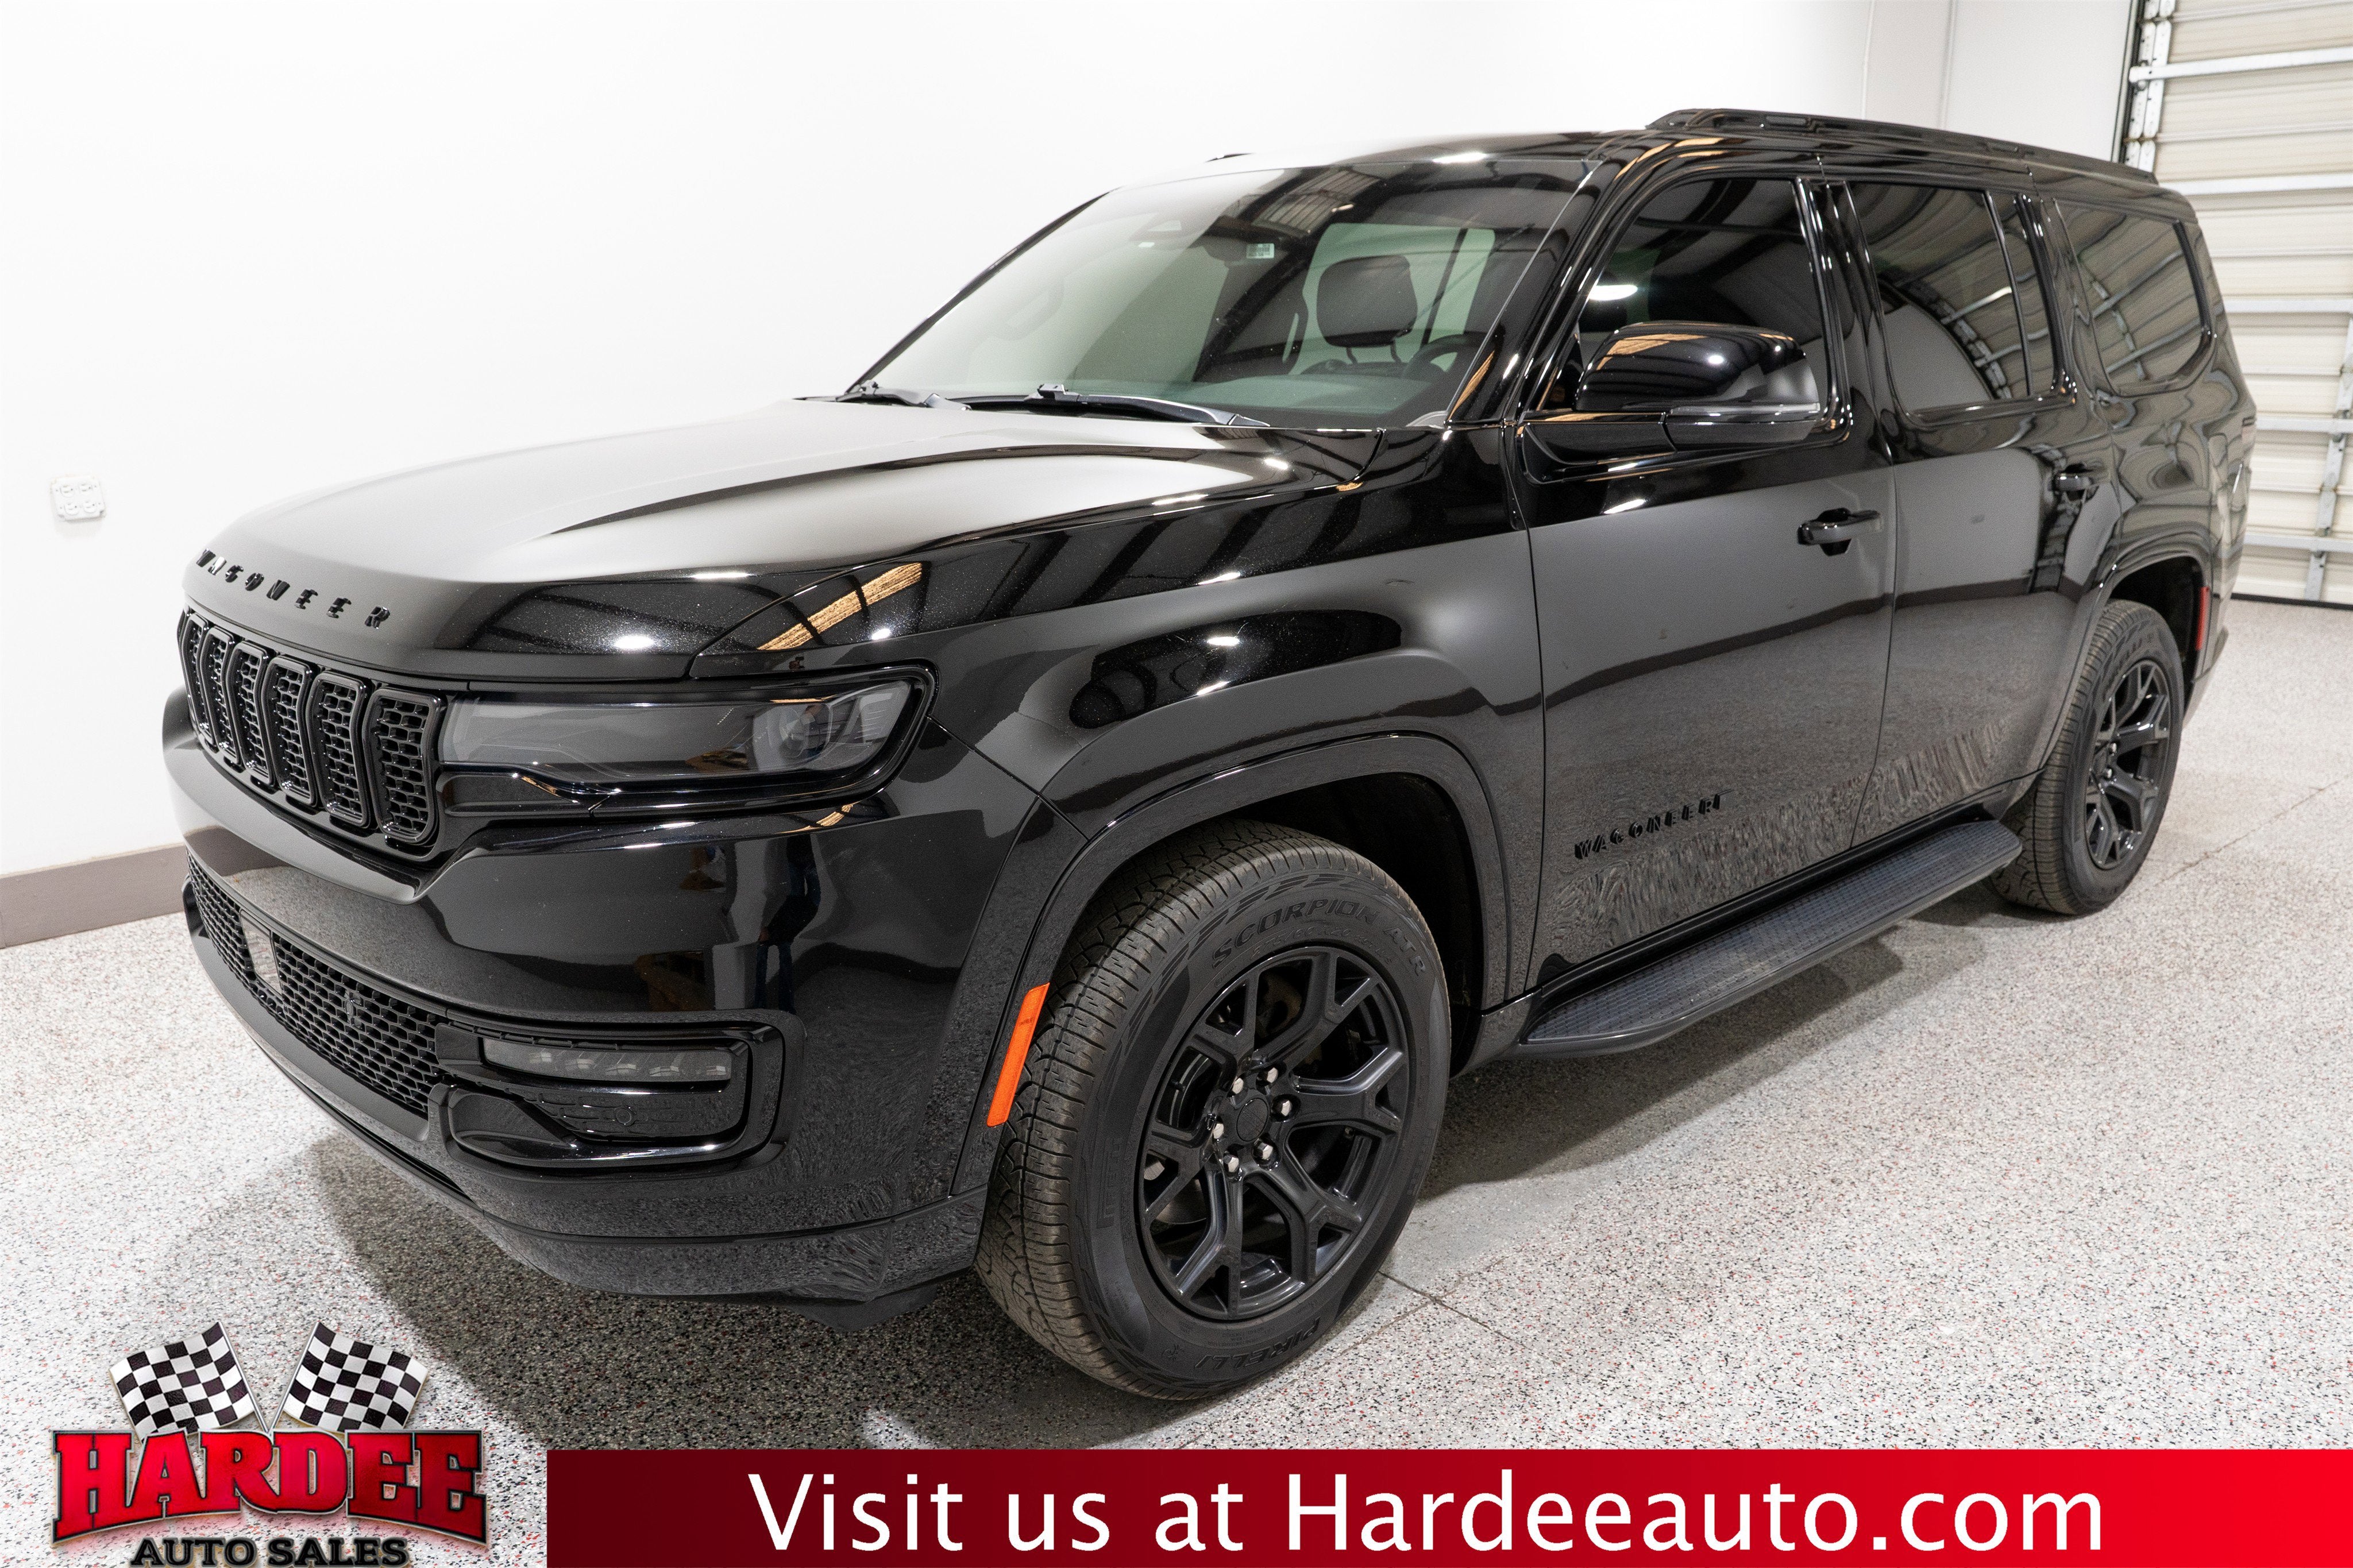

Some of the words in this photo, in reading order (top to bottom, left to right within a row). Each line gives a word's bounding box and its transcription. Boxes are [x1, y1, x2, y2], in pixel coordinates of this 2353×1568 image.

[196, 548, 390, 629] WAGONEER
[1212, 899, 1381, 969] SCORPION
[1383, 928, 1426, 976] ATR
[1194, 1315, 1321, 1370] PIRELLI
